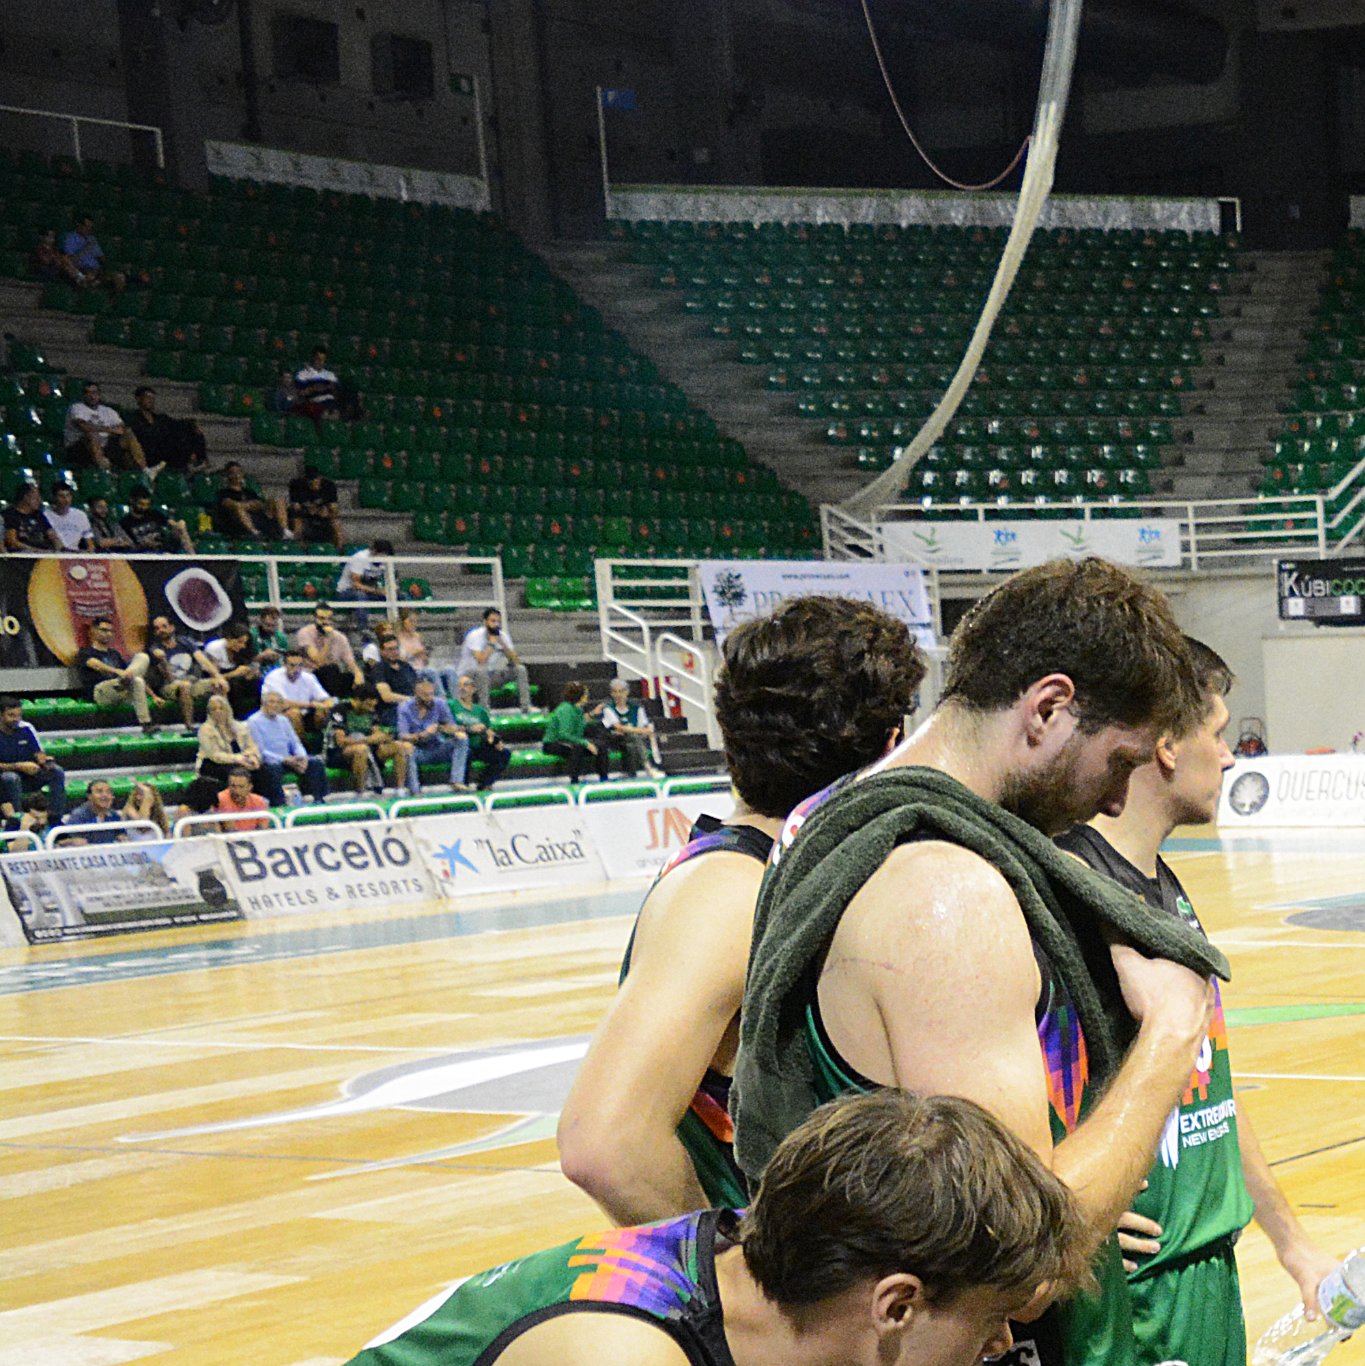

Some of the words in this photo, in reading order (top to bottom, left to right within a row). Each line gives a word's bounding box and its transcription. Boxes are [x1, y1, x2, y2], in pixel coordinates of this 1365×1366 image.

[80, 853, 109, 869] CASA
[226, 827, 411, 883] Barceló
[249, 888, 318, 911] HOTELS
[325, 886, 340, 901] &
[346, 877, 425, 901] RESORTS
